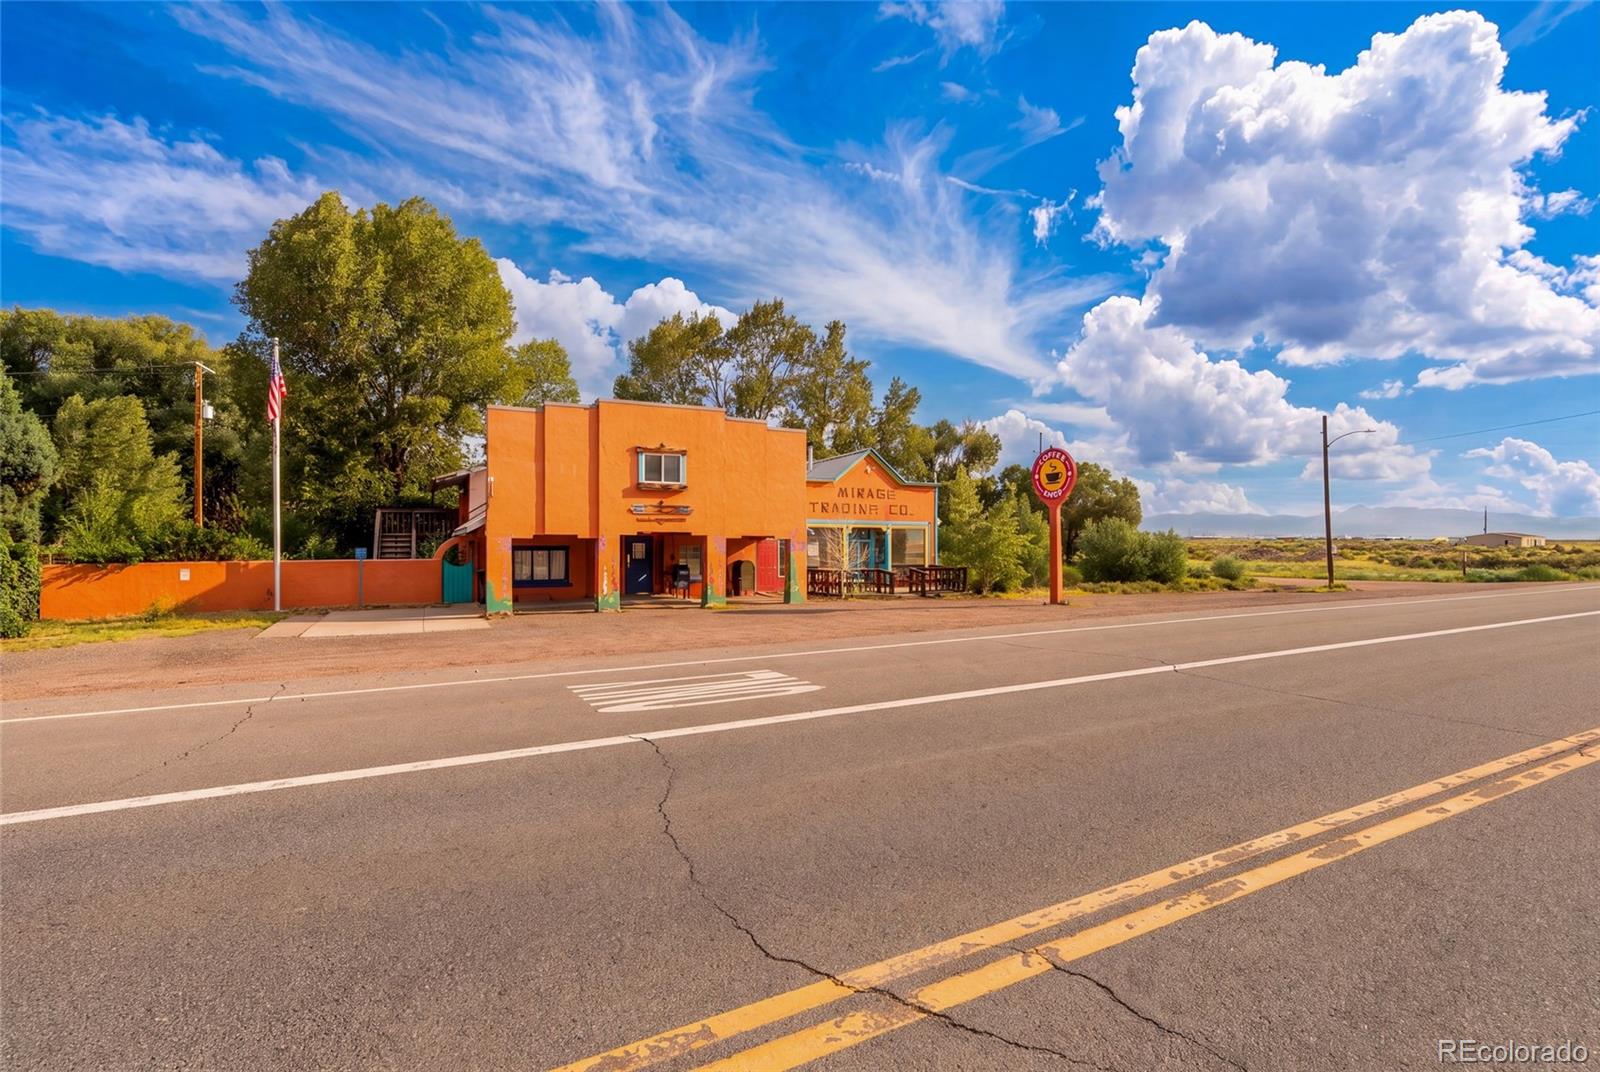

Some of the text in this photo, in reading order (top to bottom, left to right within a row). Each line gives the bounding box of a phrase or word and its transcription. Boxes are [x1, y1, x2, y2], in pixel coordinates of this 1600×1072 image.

[1038, 451, 1066, 465] COFFEE
[837, 487, 896, 500] MIRAGE
[889, 504, 915, 516] CO.
